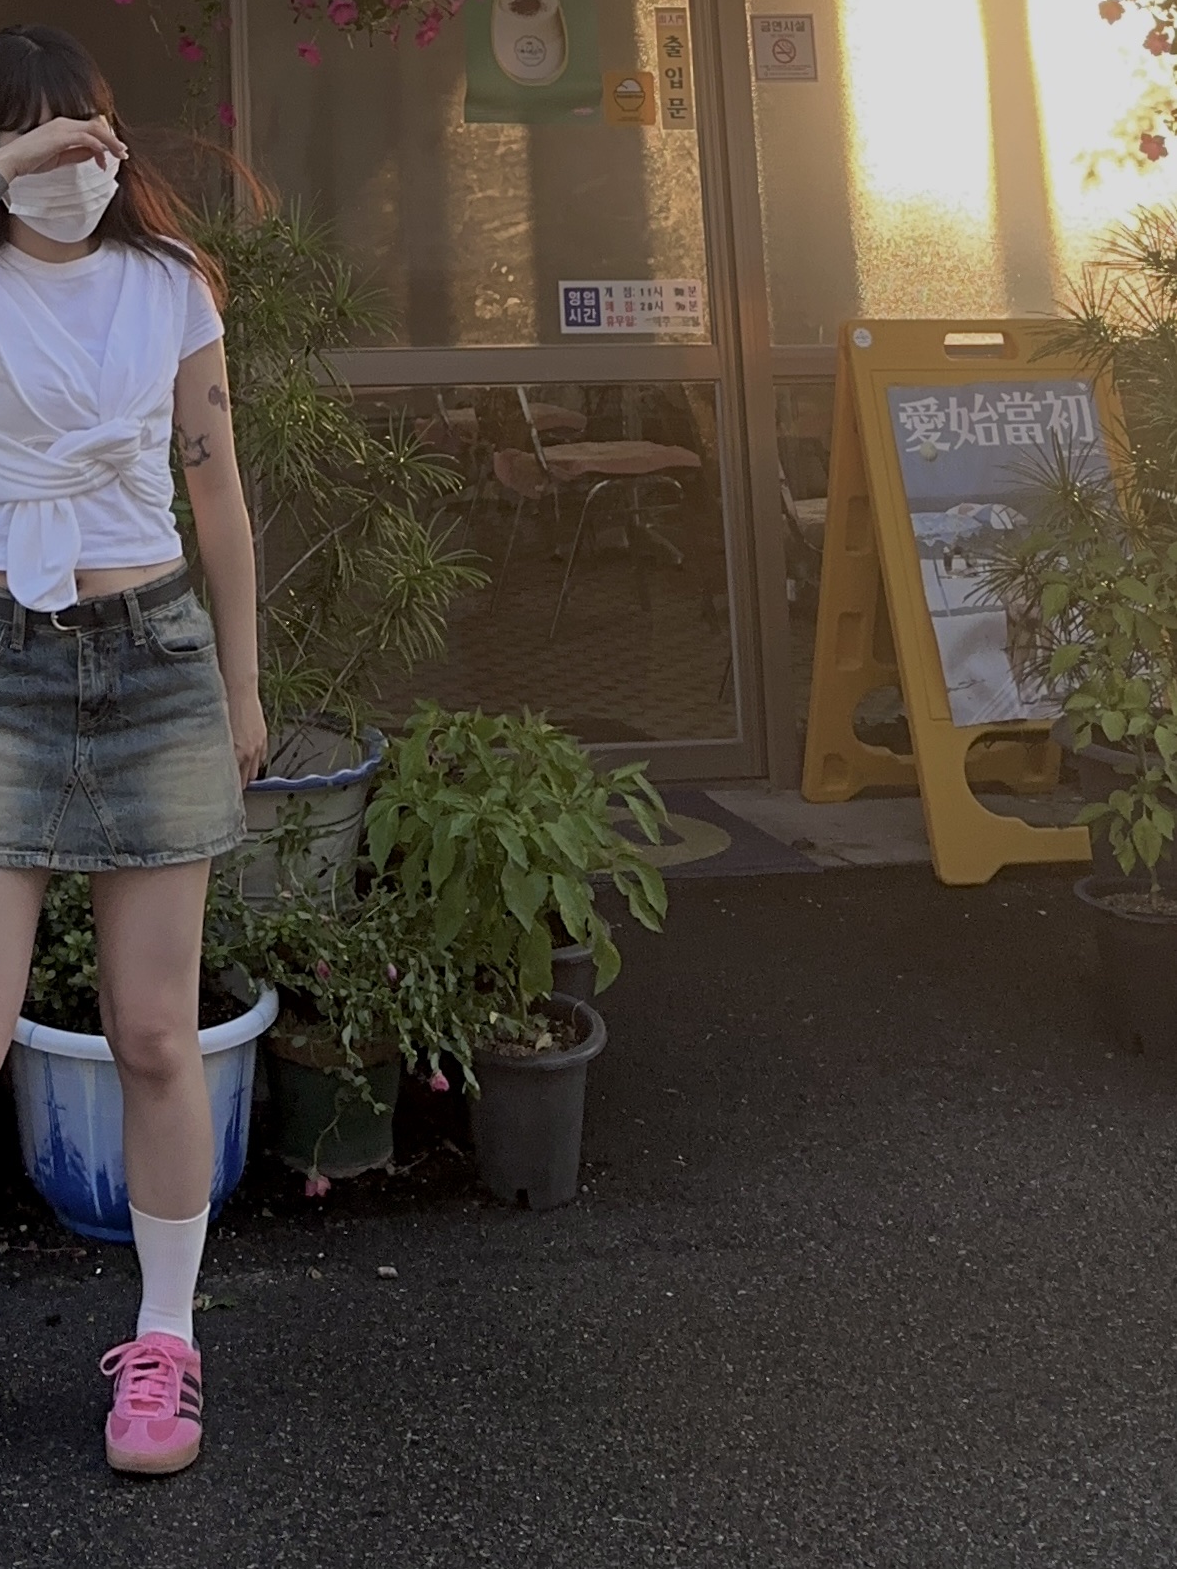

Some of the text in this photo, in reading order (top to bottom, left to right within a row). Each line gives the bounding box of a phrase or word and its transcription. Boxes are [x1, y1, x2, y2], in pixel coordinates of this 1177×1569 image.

[760, 20, 806, 33] 금연시설
[662, 34, 688, 120] 출입문
[568, 290, 596, 307] 영업
[568, 307, 597, 324] 시간
[898, 390, 1095, 453] 愛始當初
